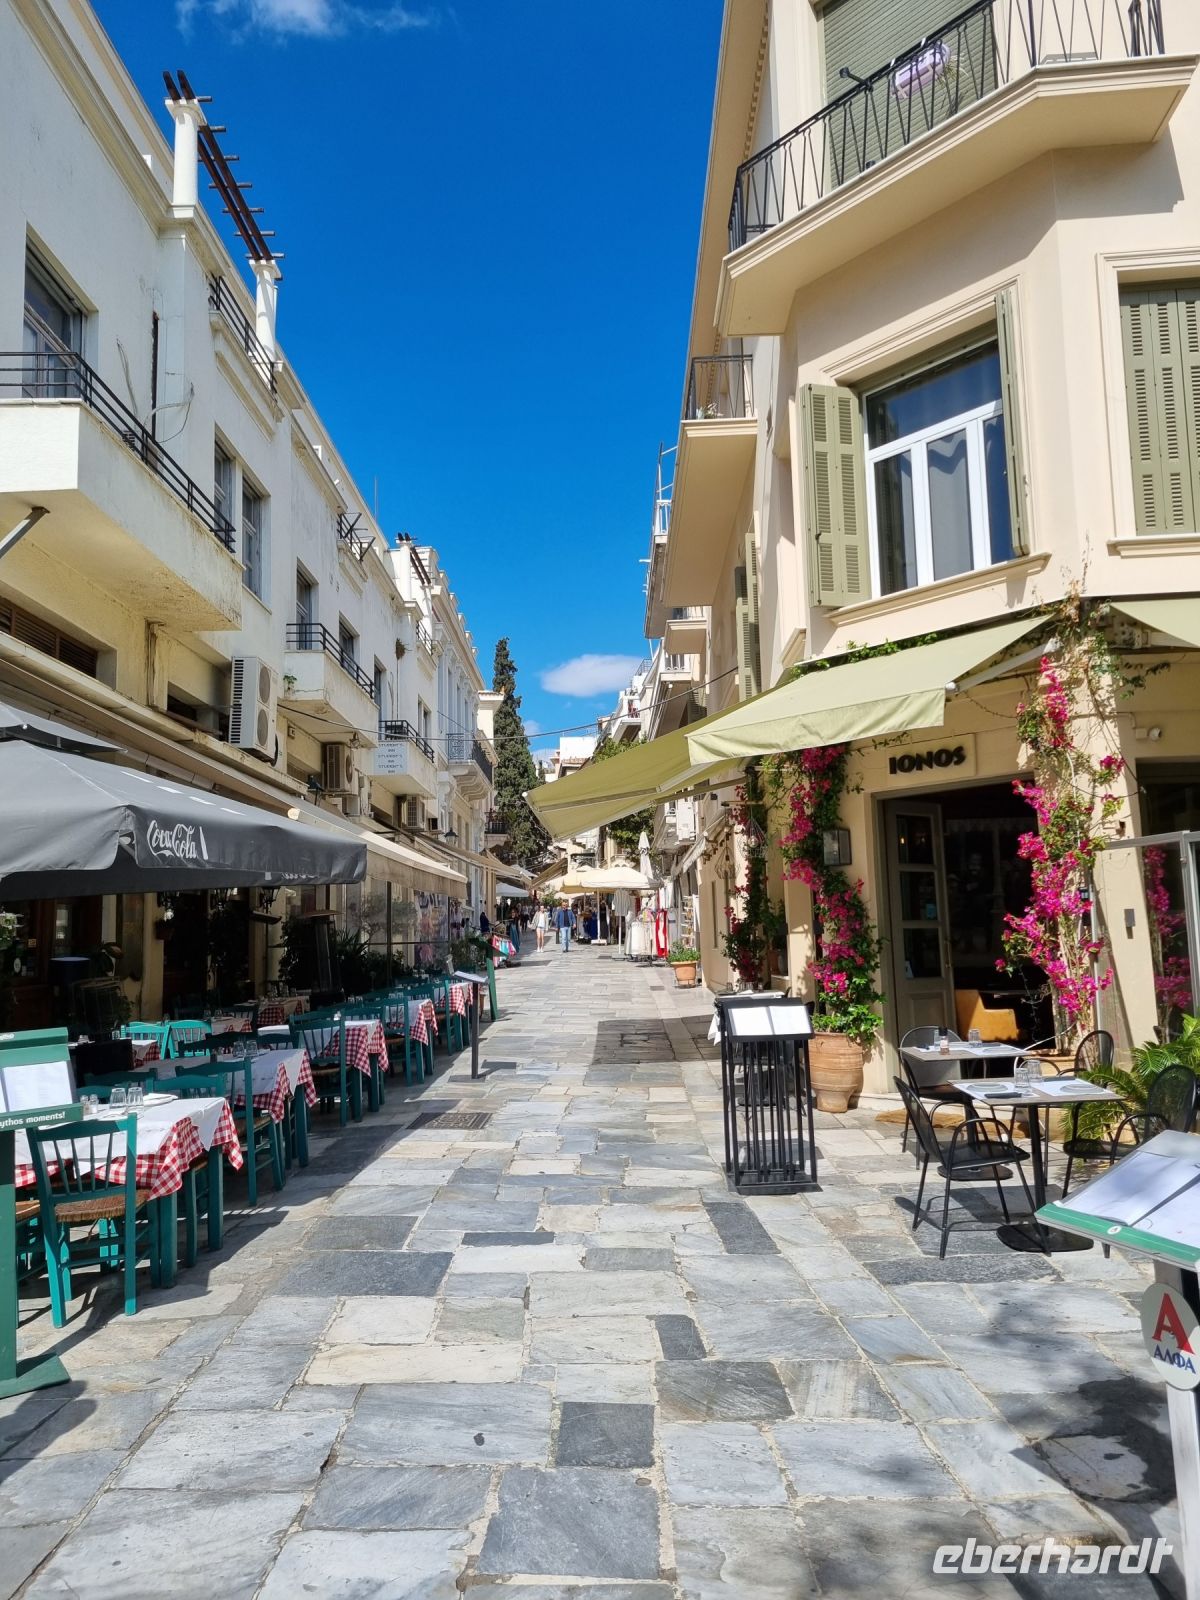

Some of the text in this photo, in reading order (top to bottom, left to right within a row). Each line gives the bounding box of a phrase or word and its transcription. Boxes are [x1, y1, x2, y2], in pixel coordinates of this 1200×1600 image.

[889, 746, 966, 774] IONOS
[0, 1111, 66, 1128] ythos moments!
